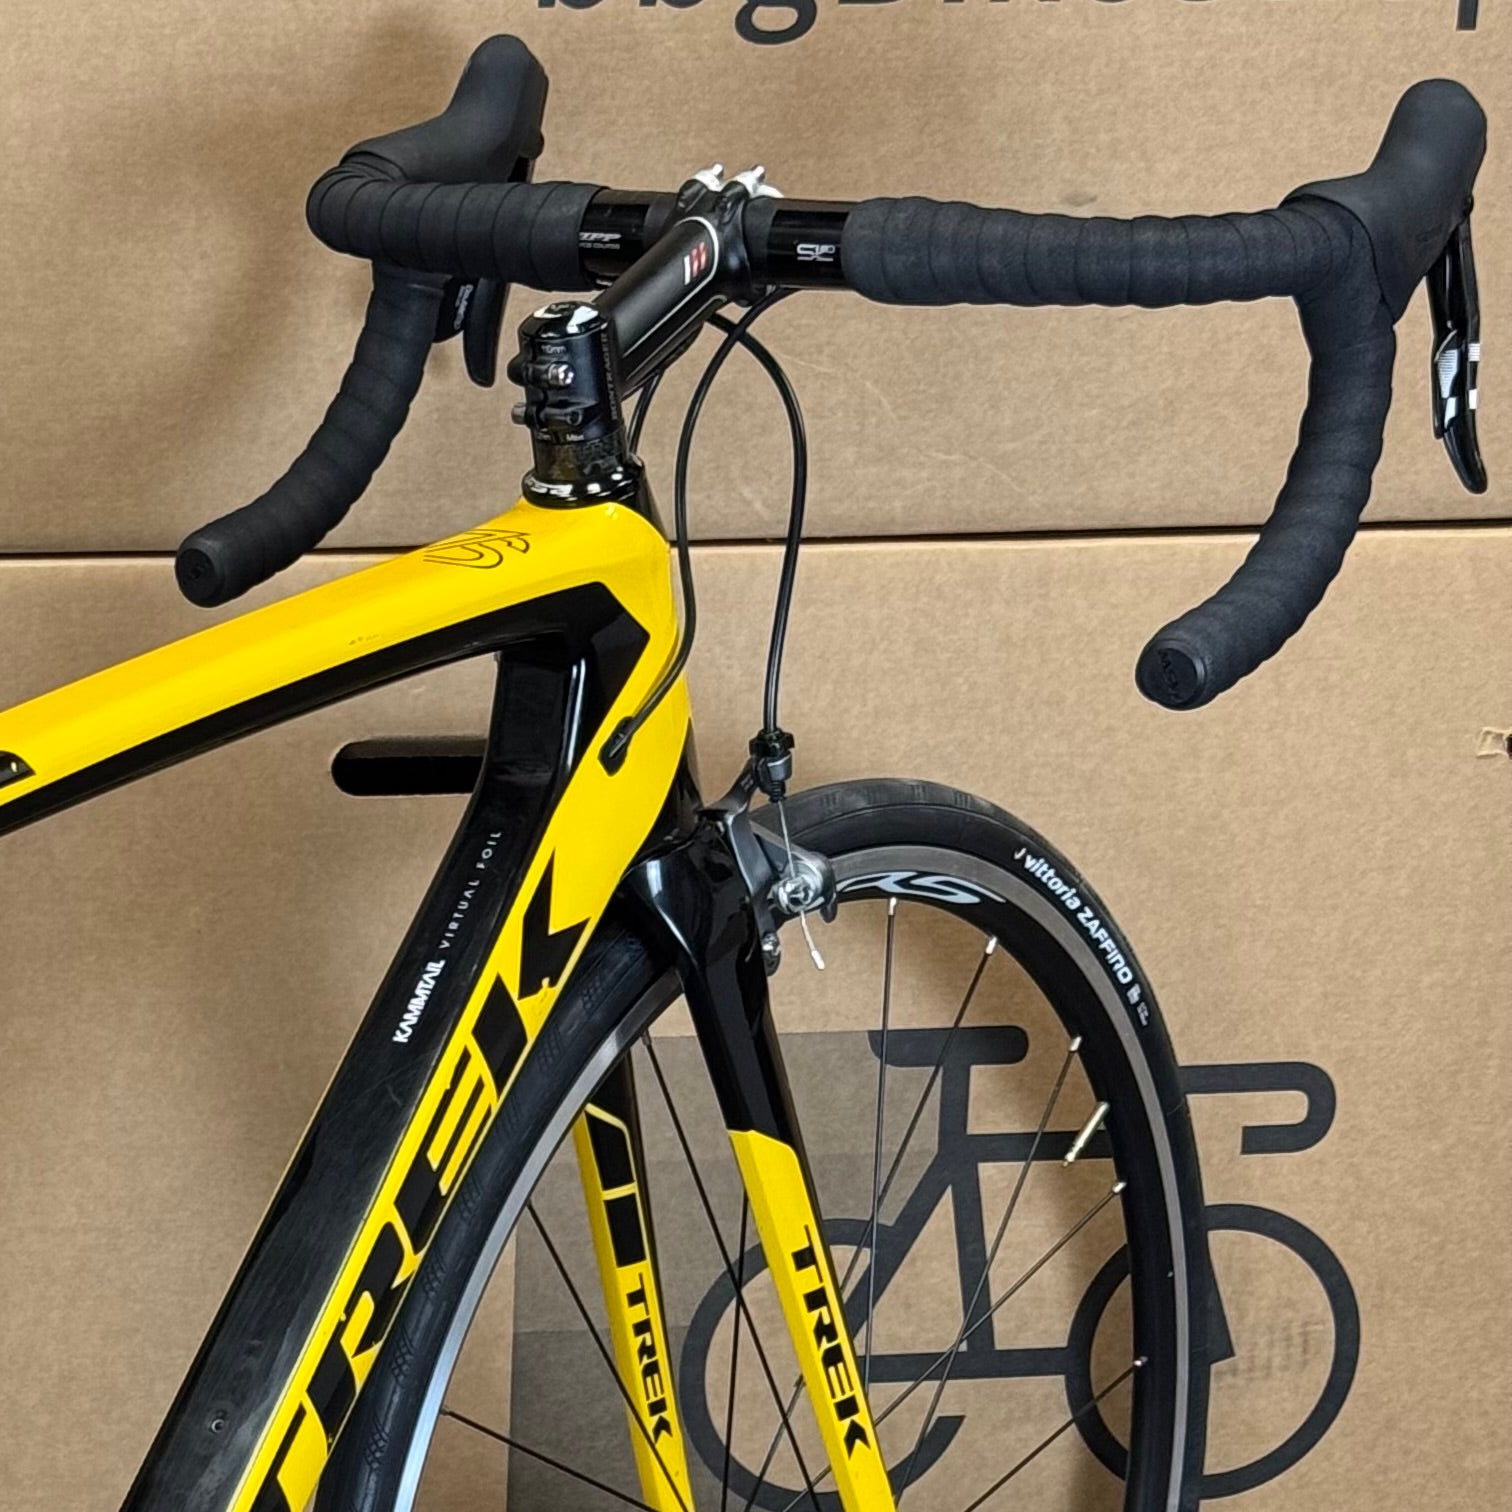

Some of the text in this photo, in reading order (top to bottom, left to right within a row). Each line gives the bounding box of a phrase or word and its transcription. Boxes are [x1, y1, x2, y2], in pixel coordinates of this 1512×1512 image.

[392, 830, 503, 1043] KAMMTAIL VIRTUAL FOIL
[1024, 853, 1134, 985] vittoria ZAFFIRO
[625, 1272, 674, 1445] TREK
[791, 1224, 871, 1461] TREK
